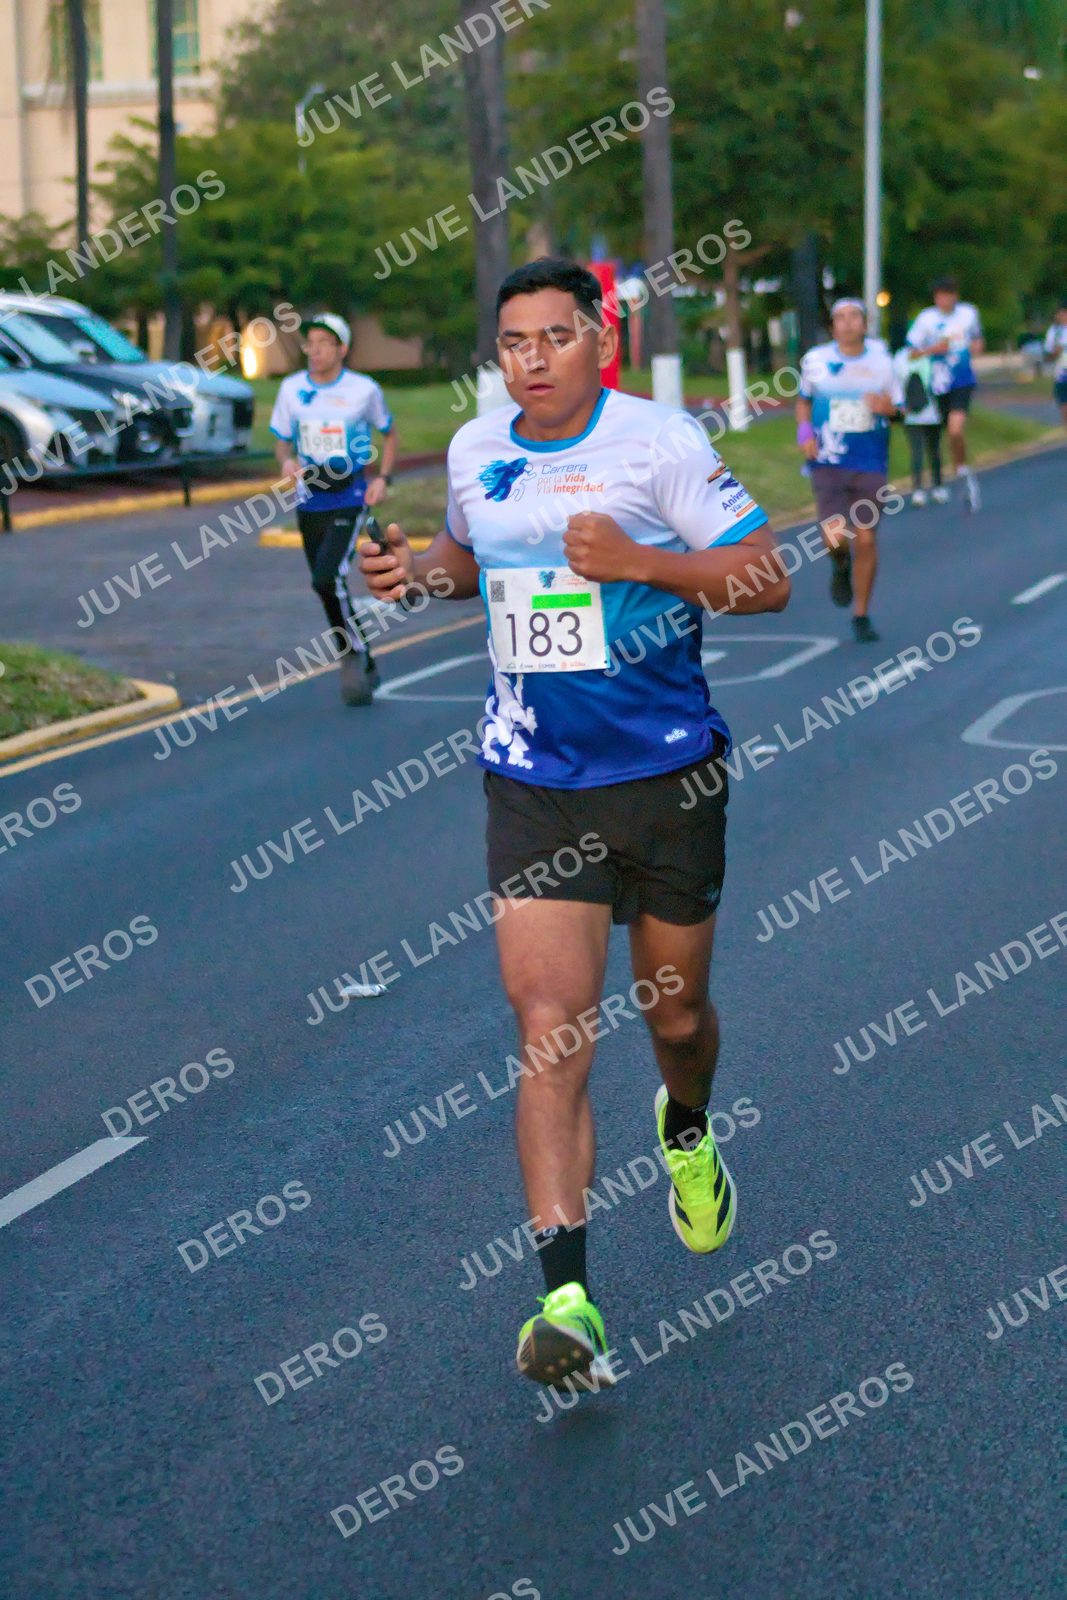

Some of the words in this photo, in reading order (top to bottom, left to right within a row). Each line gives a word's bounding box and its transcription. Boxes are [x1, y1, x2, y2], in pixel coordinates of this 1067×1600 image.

[541, 464, 588, 475] Carrera
[564, 473, 586, 483] Vida
[553, 482, 604, 495] Integridad
[505, 611, 583, 657] 183
